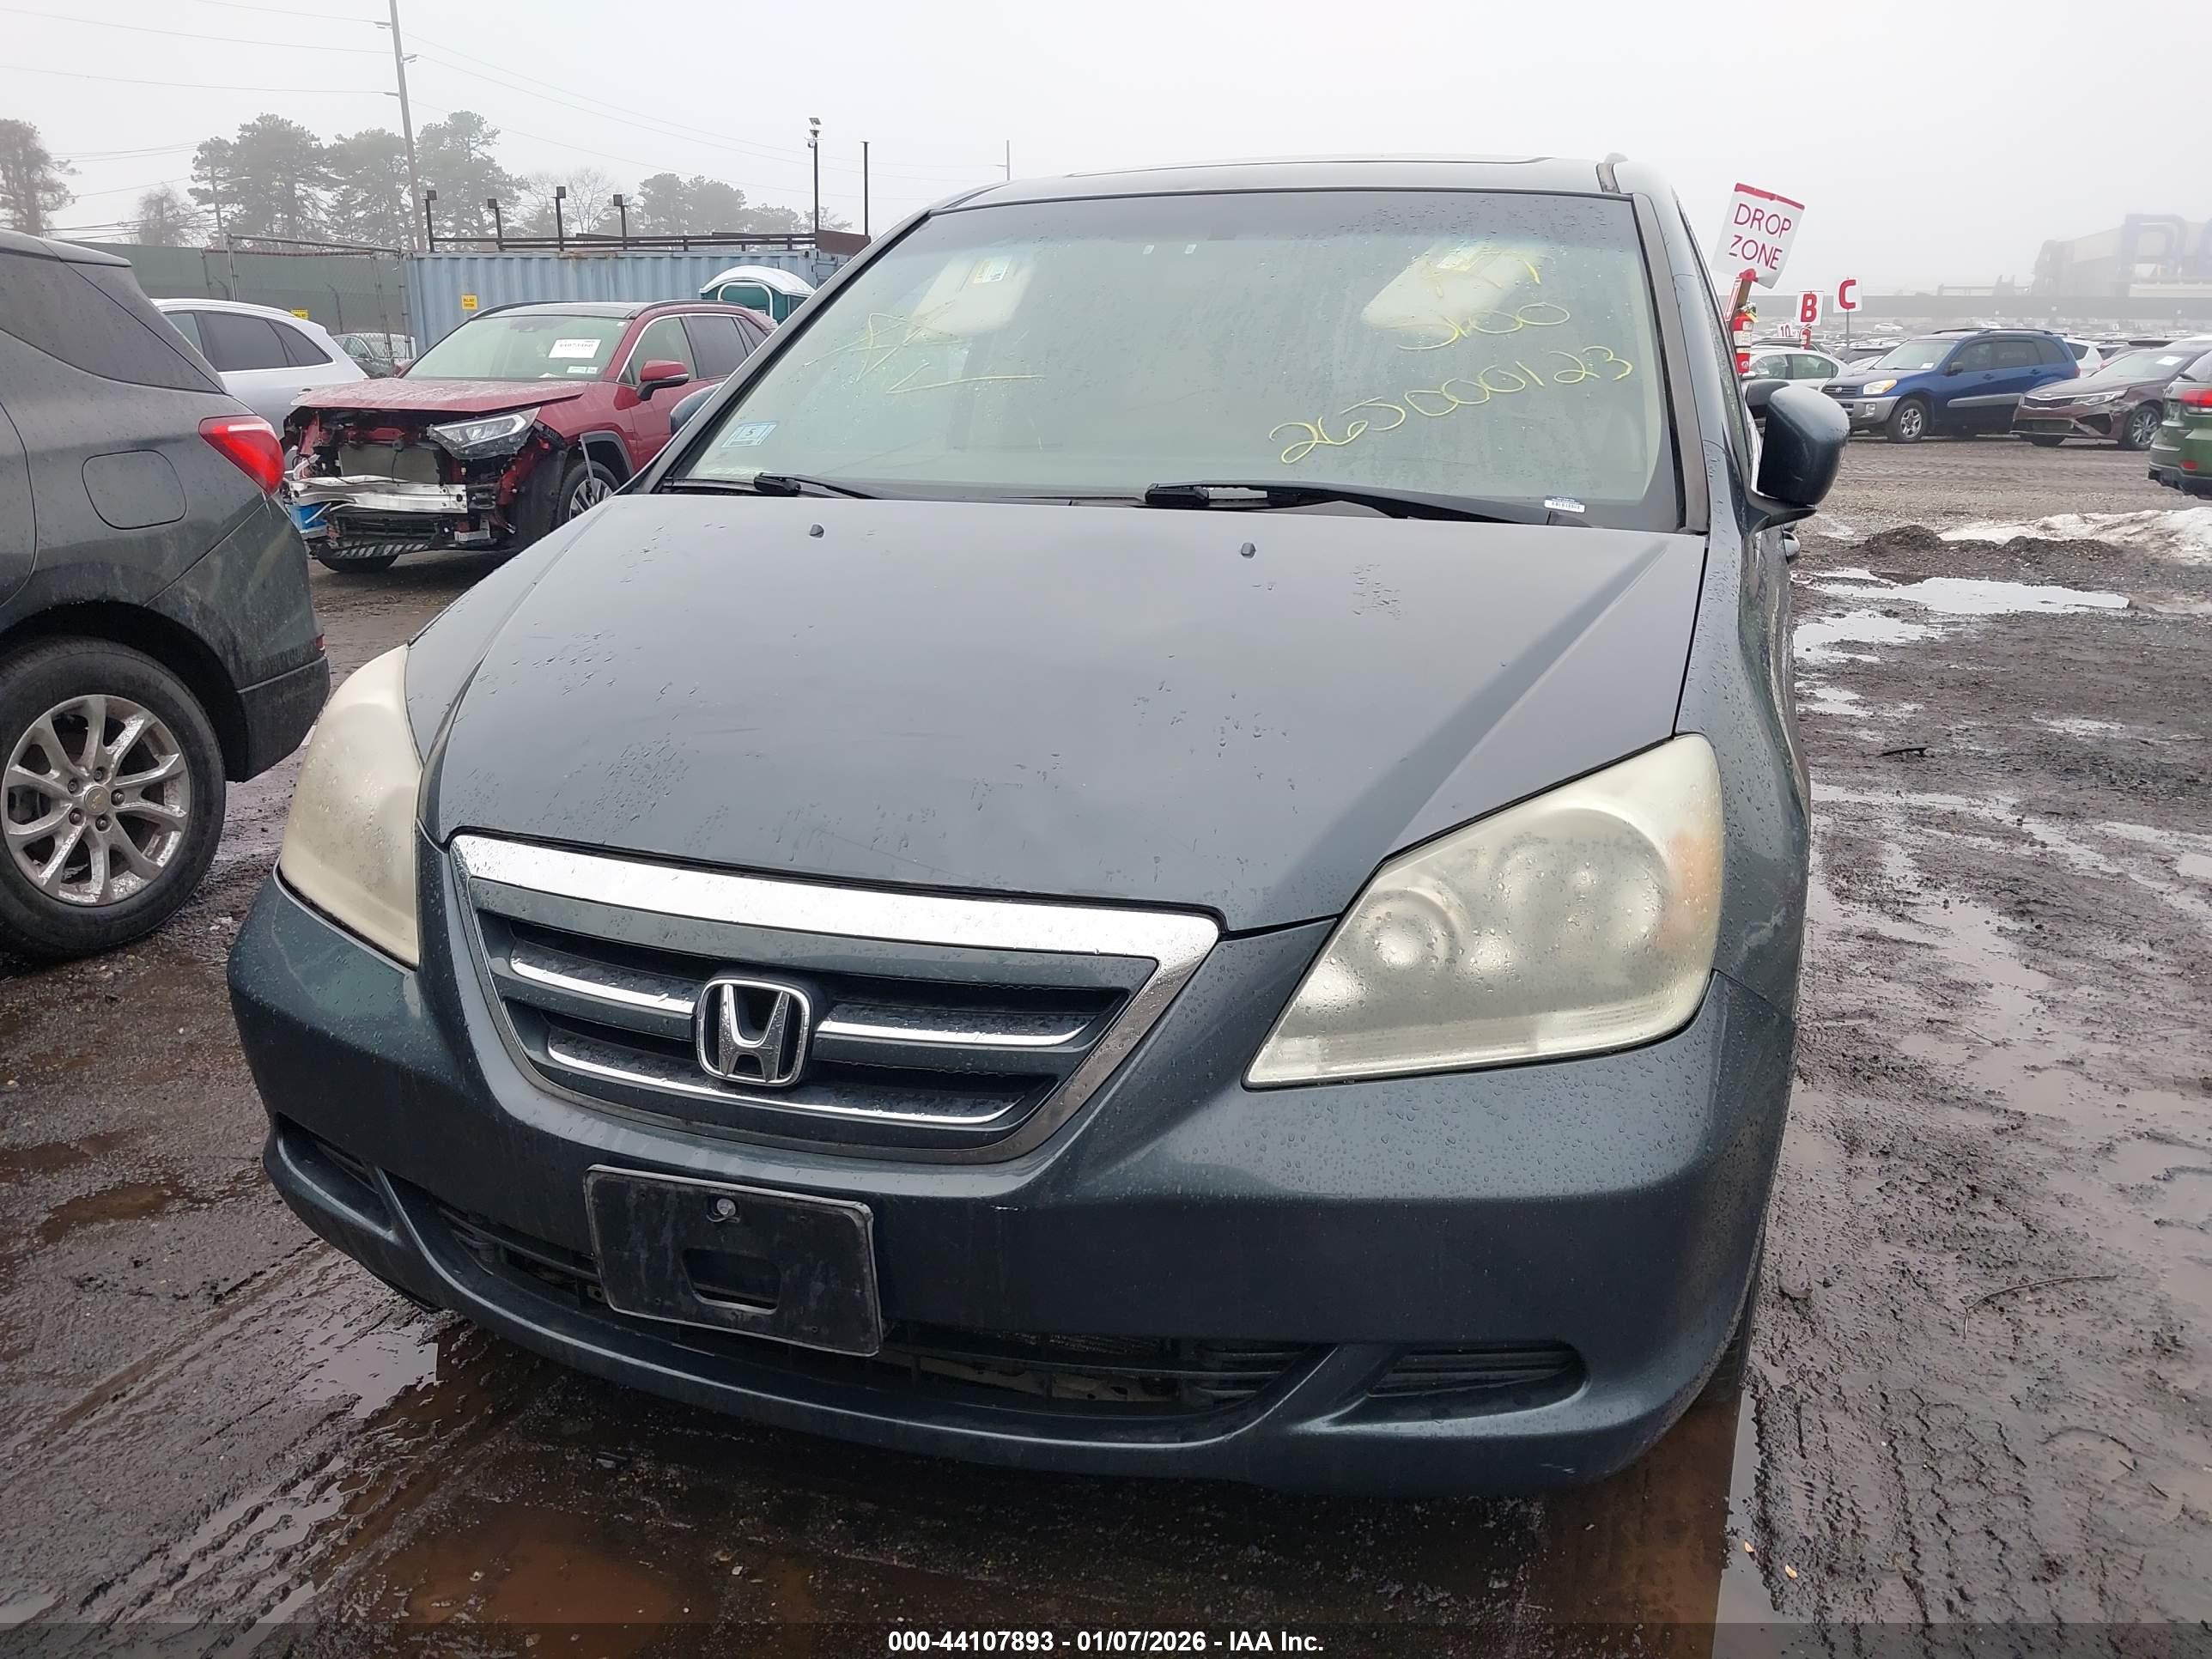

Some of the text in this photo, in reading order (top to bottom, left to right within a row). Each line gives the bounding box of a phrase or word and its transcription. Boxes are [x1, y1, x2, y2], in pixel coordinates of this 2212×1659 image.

[1733, 203, 1792, 239] DROP
[1729, 234, 1783, 270] ZONE
[1800, 293, 1818, 323] B
[1838, 279, 1856, 310] C
